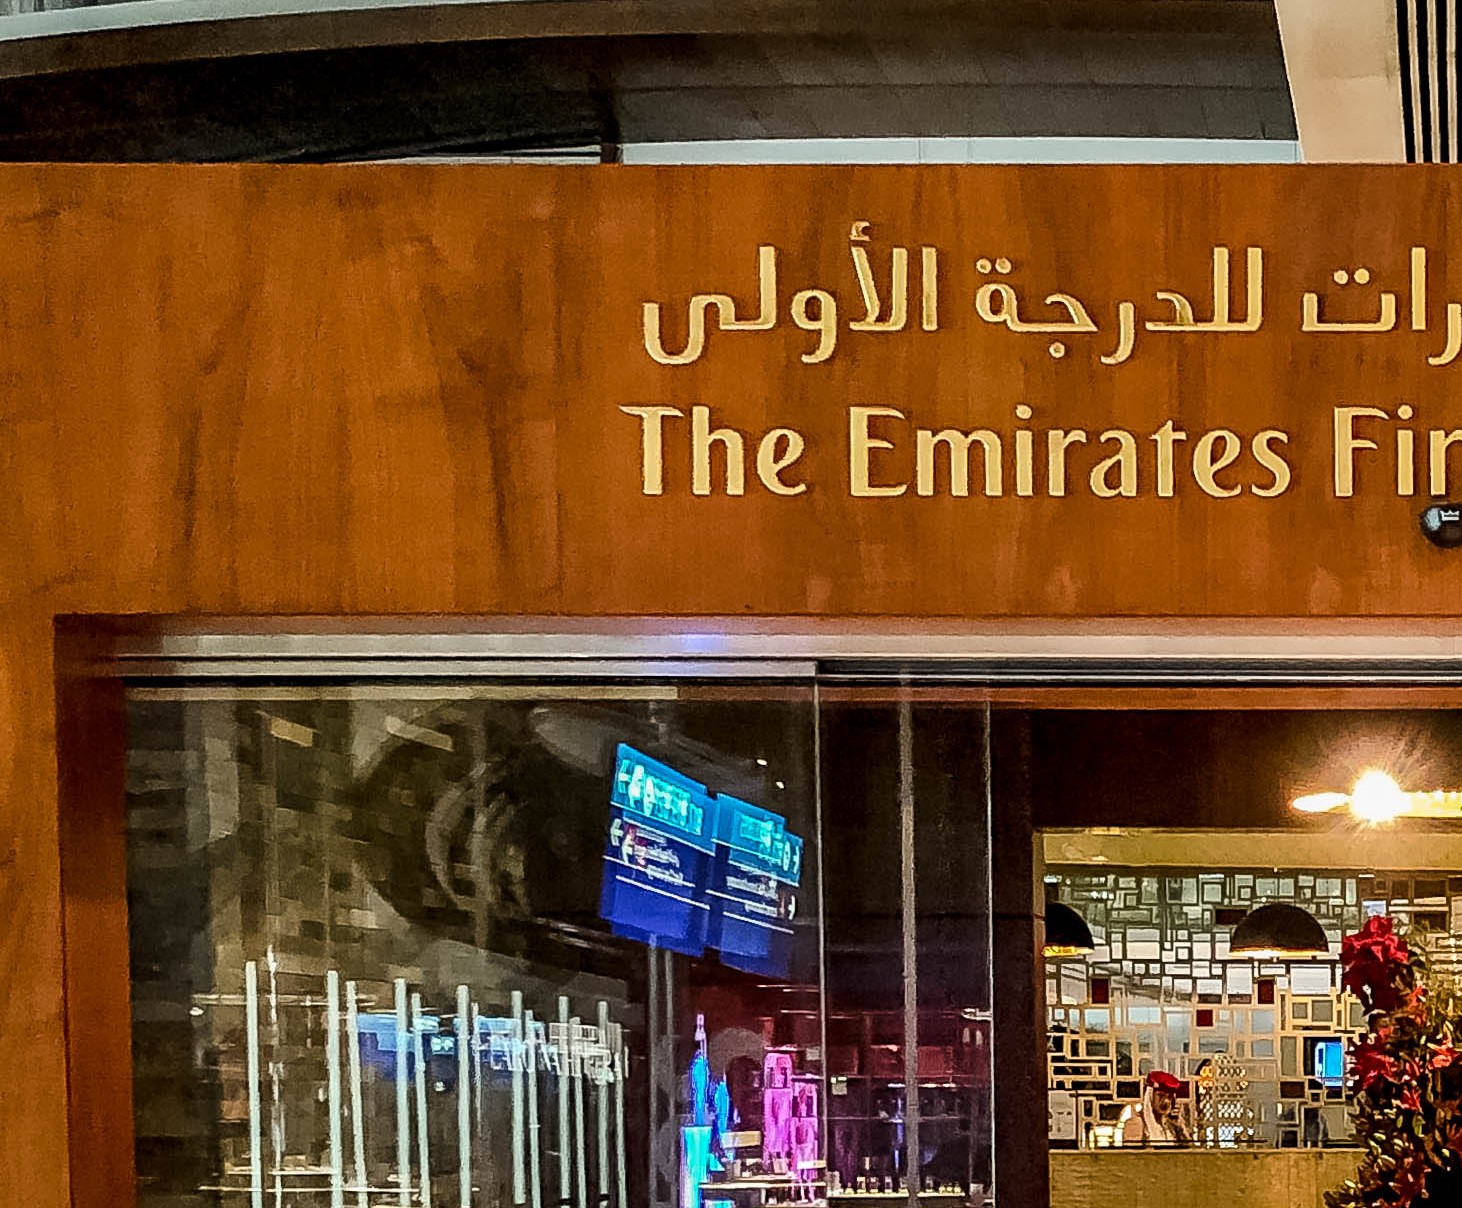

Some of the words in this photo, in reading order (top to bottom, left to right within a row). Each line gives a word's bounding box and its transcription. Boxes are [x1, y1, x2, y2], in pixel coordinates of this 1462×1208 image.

[641, 220, 939, 366] الأولى
[975, 246, 1264, 366] للدرجة
[618, 404, 808, 497] The
[849, 403, 1292, 498] Emirates
